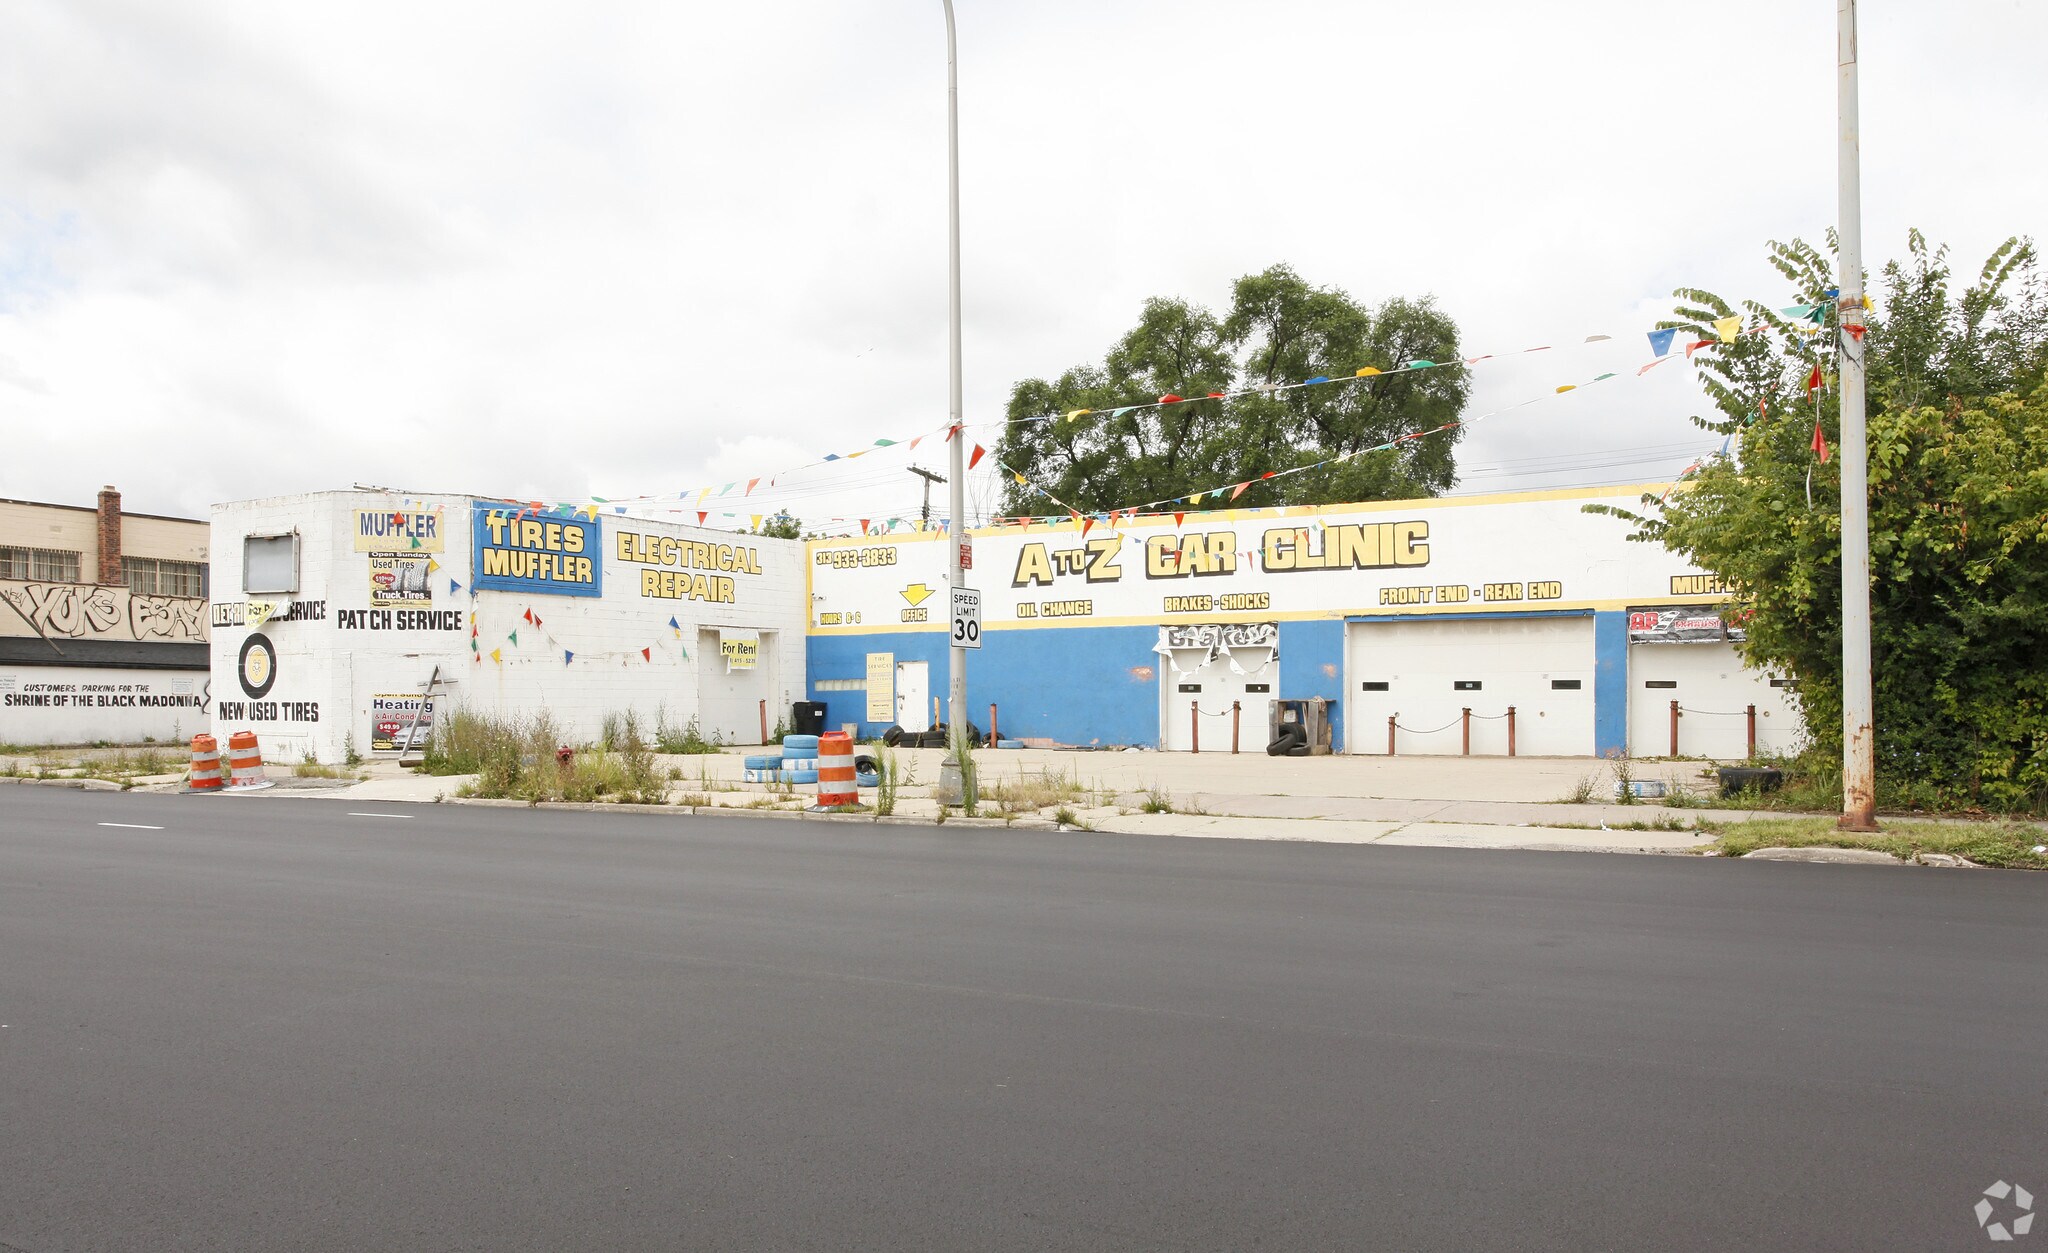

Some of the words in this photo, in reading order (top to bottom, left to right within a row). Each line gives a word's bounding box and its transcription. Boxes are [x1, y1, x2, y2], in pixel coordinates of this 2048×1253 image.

[485, 515, 584, 553] TIRES
[616, 531, 763, 576] ELECTRICAL
[816, 551, 833, 565] 313
[833, 547, 897, 569] 933-3833
[1011, 542, 1054, 588] A
[1086, 538, 1122, 584] Z
[1145, 531, 1237, 580] CAR
[1262, 521, 1429, 573] CLINIC
[372, 559, 393, 569] Used
[394, 559, 415, 569] Tires
[482, 547, 594, 584] MUFFLER
[376, 591, 401, 599] Truck
[402, 591, 425, 599] Tires
[641, 568, 736, 604] REPAIR
[1379, 586, 1433, 605] FRONT
[1436, 585, 1469, 603] END
[1483, 582, 1523, 601] REAR
[1528, 581, 1562, 600] END
[953, 594, 979, 606] SPEED
[1016, 603, 1038, 618] OIL
[1041, 600, 1093, 617] CHANGE
[1163, 595, 1213, 612] BRAKES
[1220, 592, 1270, 610] SHOCKS
[338, 610, 392, 629] PATCH
[396, 610, 462, 630] SERVICE
[820, 612, 842, 625] HOURS
[901, 608, 927, 622] OFFICE
[956, 606, 976, 617] LIMIT
[954, 618, 979, 641] 30
[722, 642, 735, 654] For
[24, 684, 77, 692] CUSTOMERS
[82, 684, 116, 692] PARKING
[118, 684, 132, 692] FOR
[135, 684, 149, 692] THE
[5, 694, 50, 707] SHRINE
[53, 695, 69, 707] OF
[72, 695, 94, 707] THE
[97, 695, 136, 707] BLACK
[139, 695, 201, 707] MADONNA
[219, 702, 244, 721] NEW
[249, 702, 278, 721] USED
[281, 702, 319, 722] TIRES
